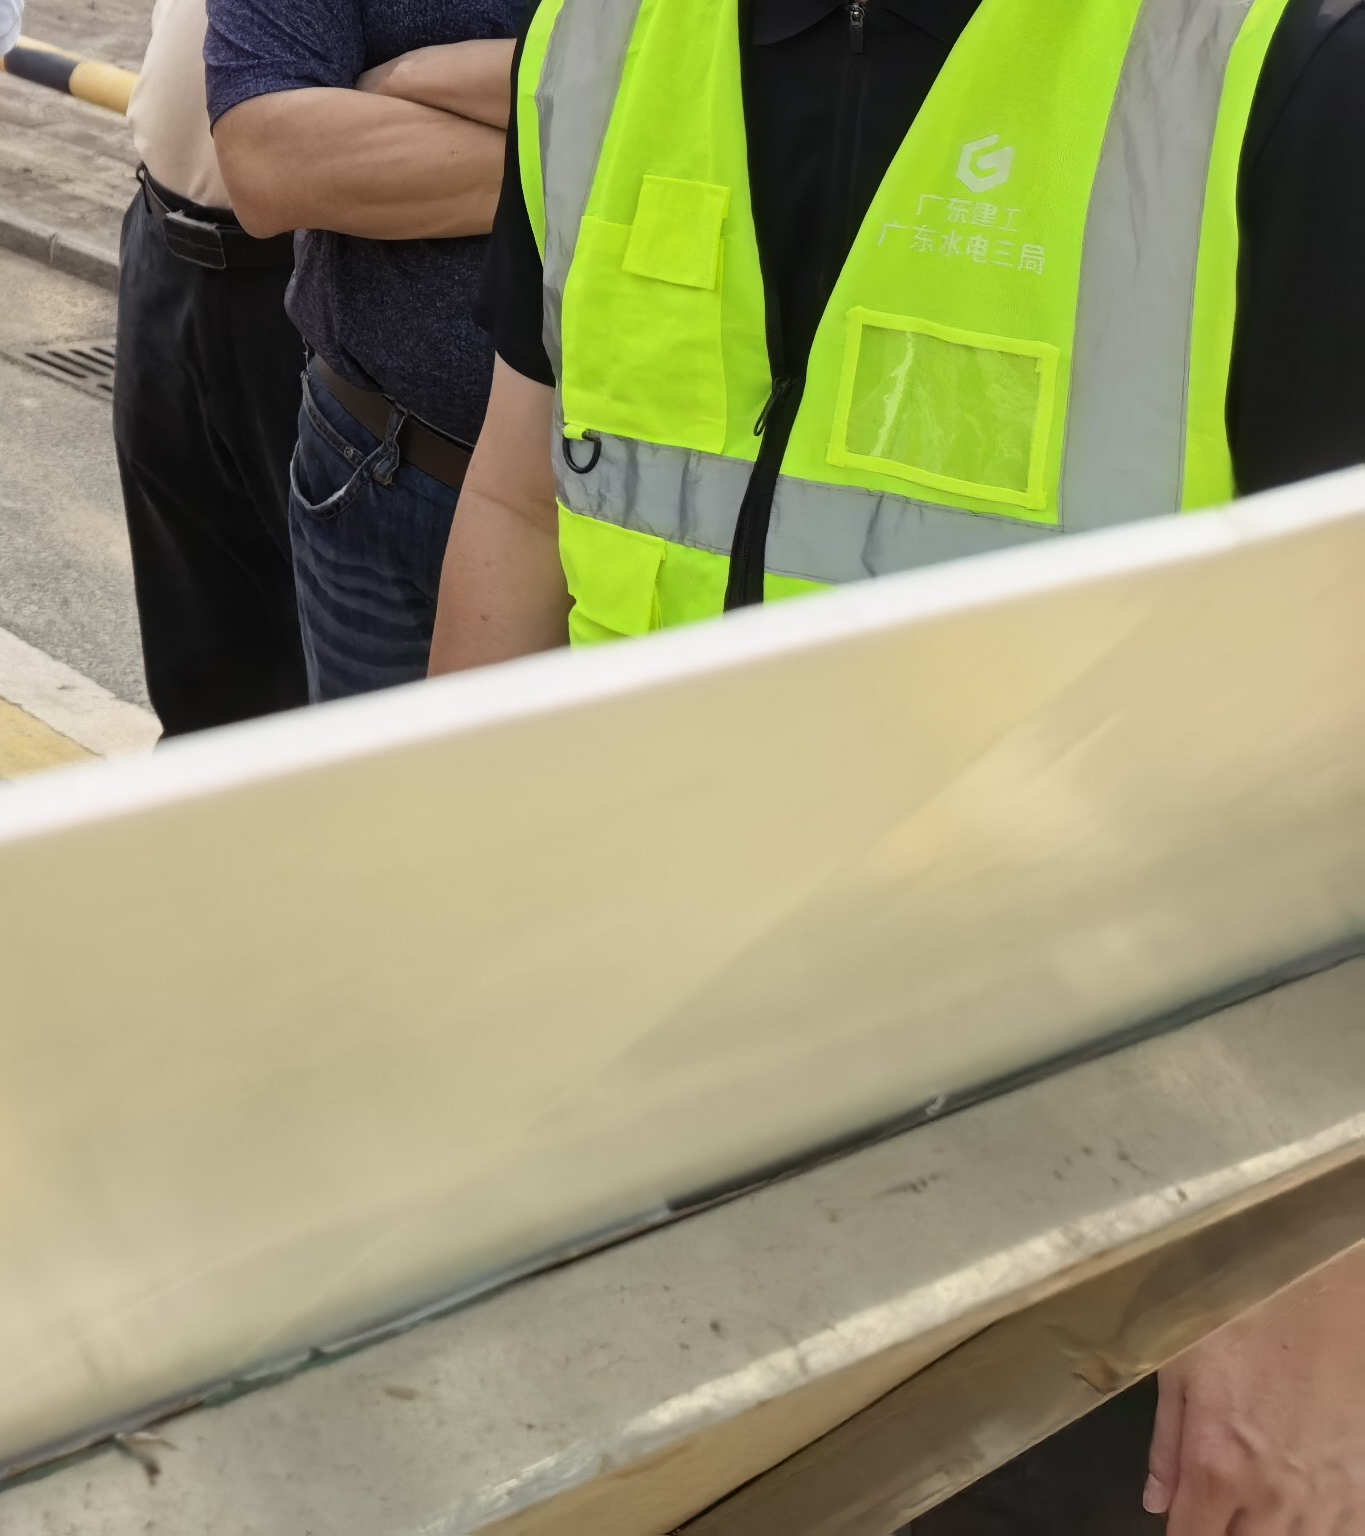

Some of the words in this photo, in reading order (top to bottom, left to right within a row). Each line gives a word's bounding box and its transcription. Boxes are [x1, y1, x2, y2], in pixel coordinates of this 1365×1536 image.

[915, 193, 1025, 232] 广东建工
[877, 221, 1046, 276] 广东水电三局
